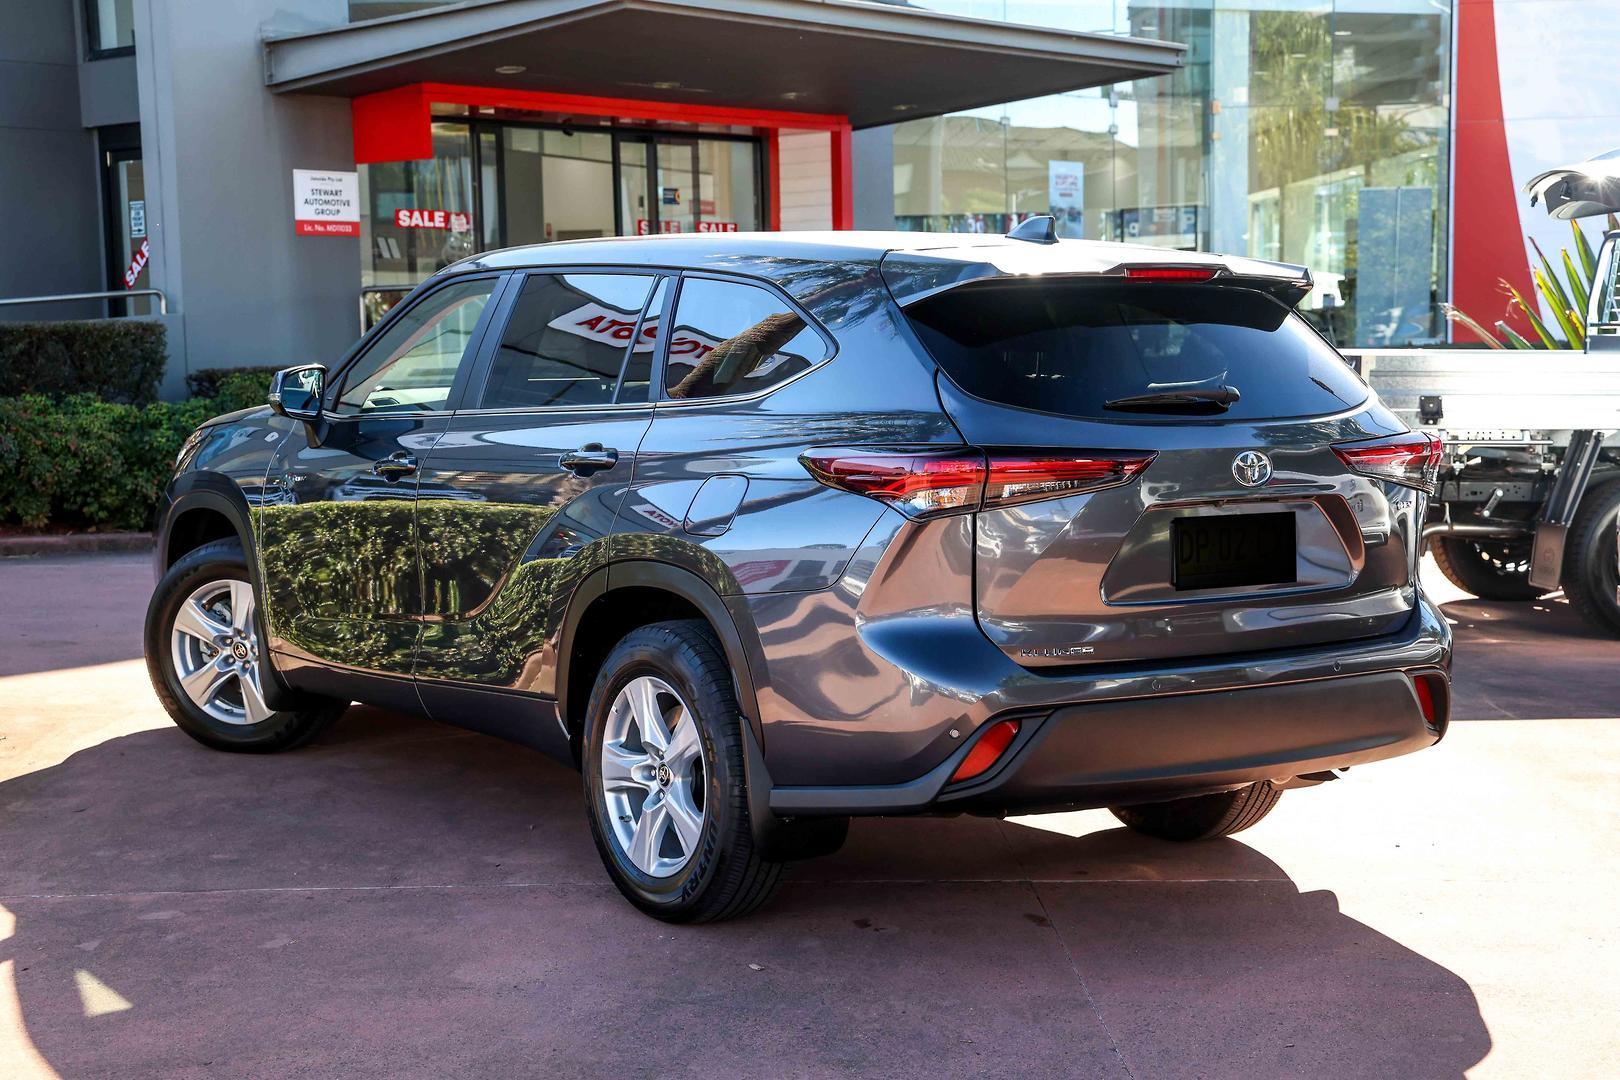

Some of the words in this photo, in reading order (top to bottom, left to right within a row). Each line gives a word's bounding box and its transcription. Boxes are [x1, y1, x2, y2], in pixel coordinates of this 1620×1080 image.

[399, 210, 445, 227] SALE
[640, 221, 679, 234] SLE
[699, 222, 735, 232] SALE
[126, 240, 149, 286] SALE
